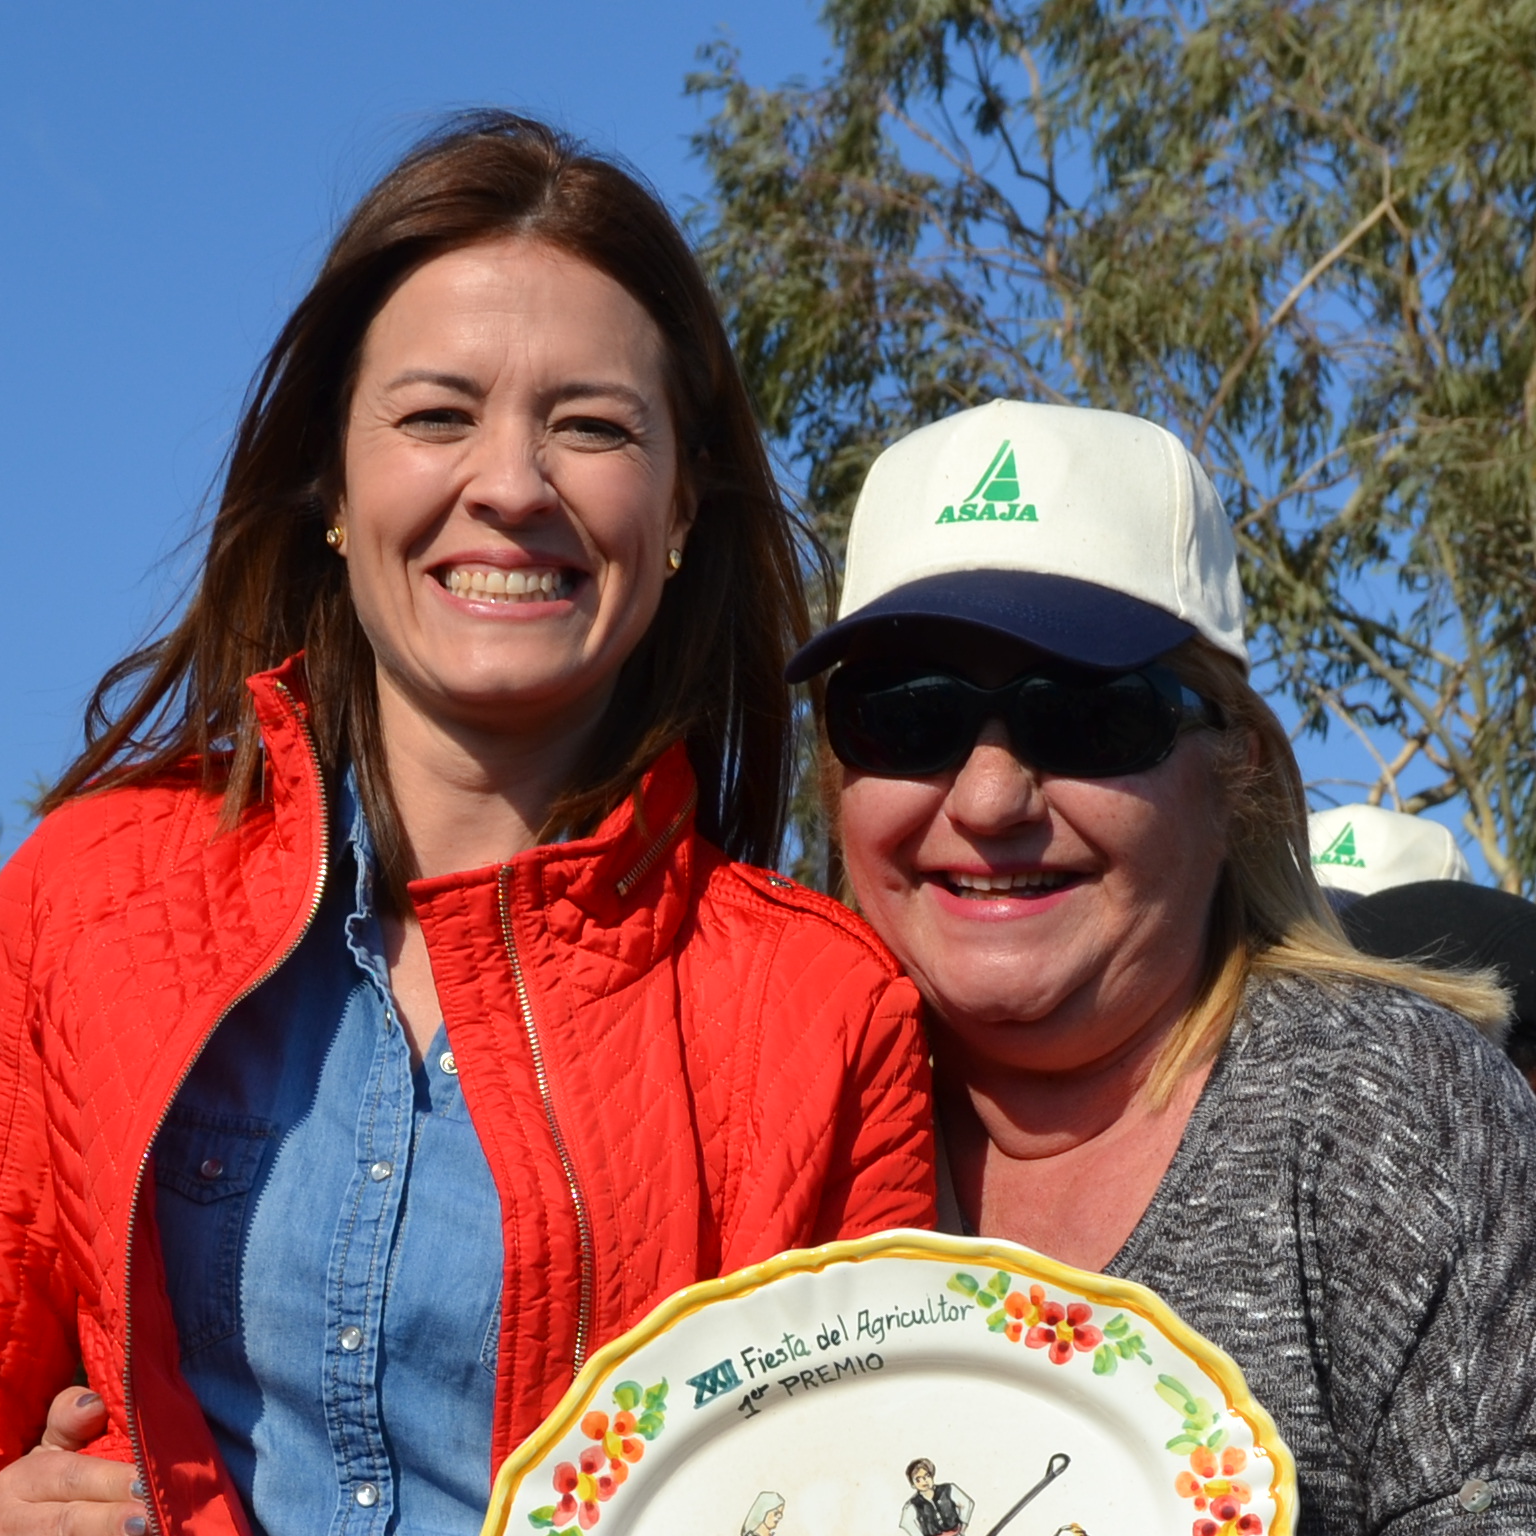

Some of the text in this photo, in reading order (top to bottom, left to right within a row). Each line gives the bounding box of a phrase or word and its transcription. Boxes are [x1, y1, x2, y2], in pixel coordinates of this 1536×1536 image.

[935, 503, 1039, 524] ASAJA
[686, 1293, 975, 1409] XXII Fiesta del Agricultor
[737, 1352, 884, 1419] 1er PREMIO
